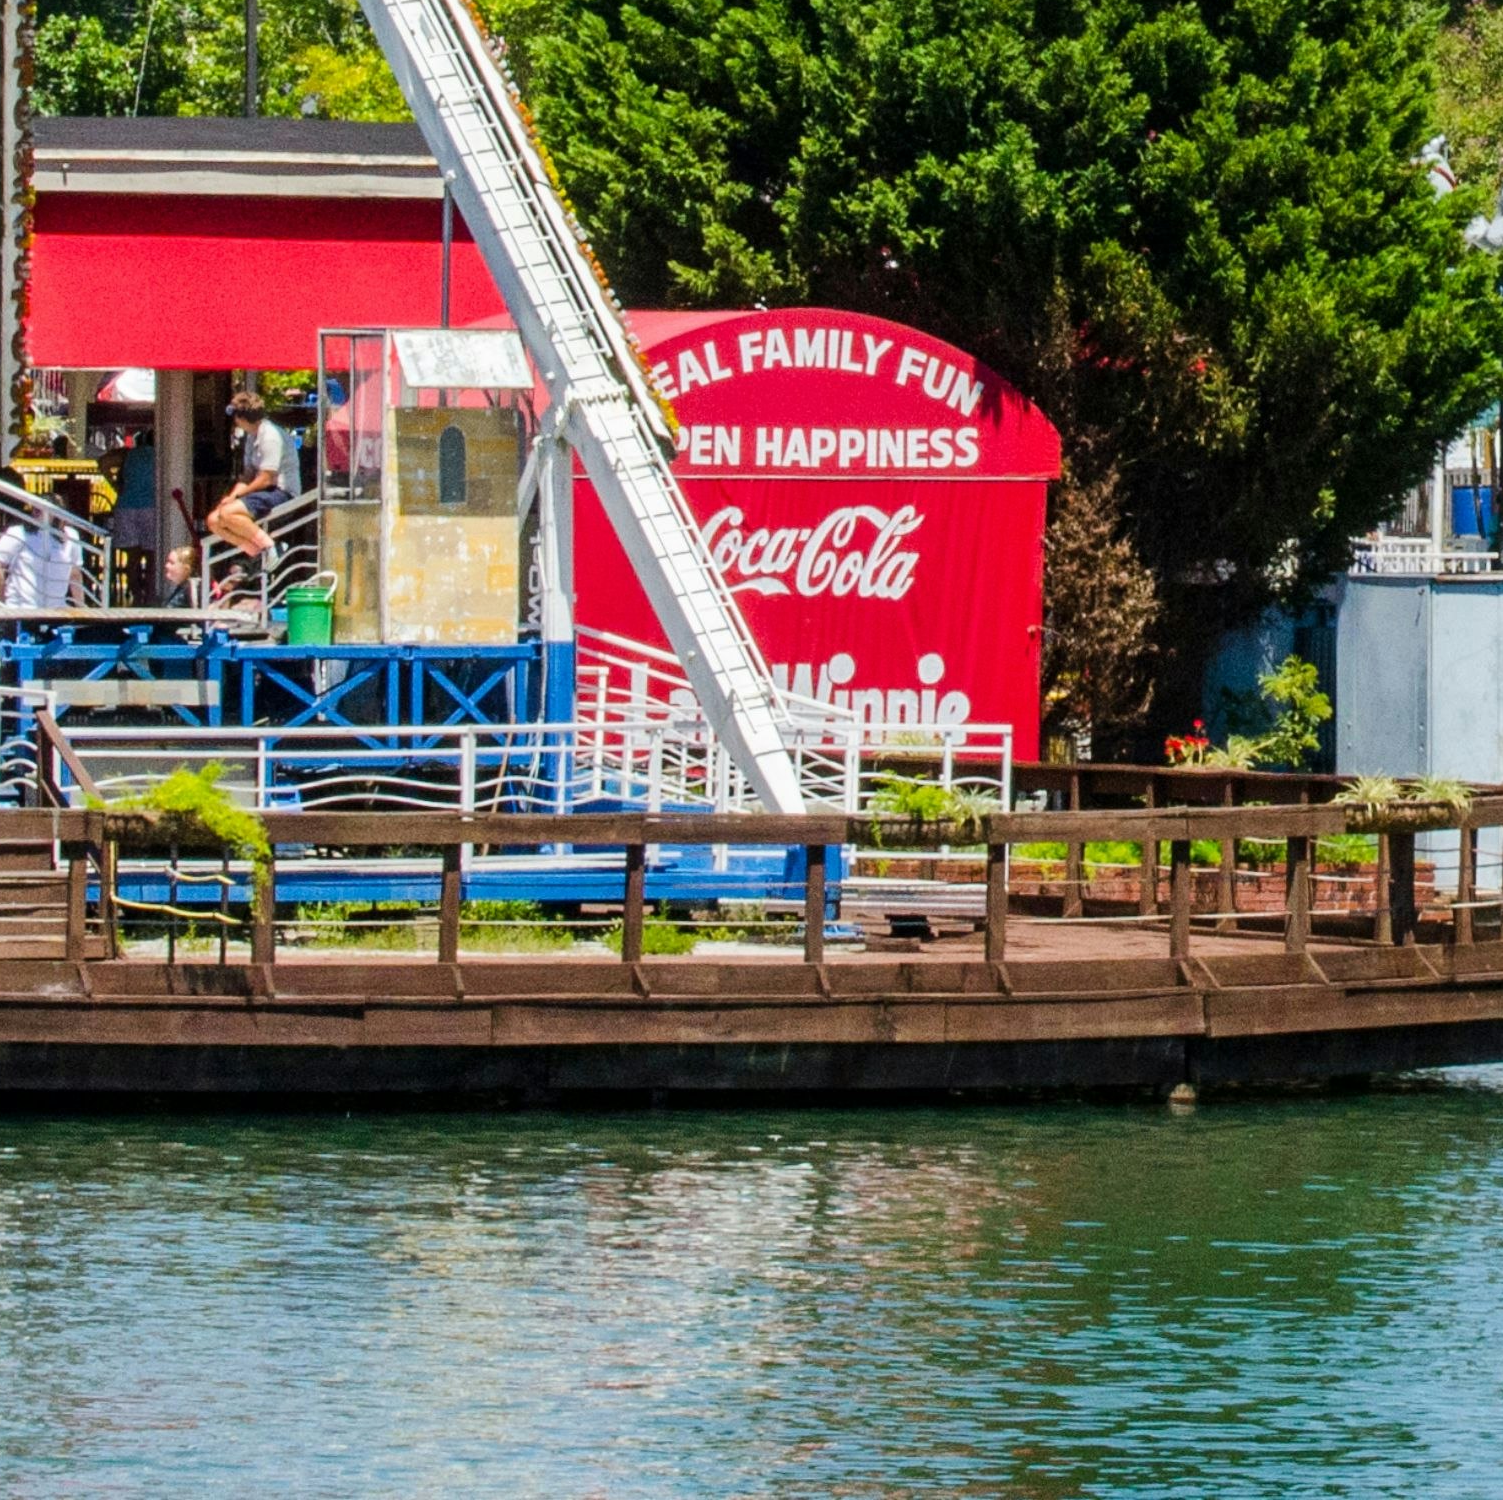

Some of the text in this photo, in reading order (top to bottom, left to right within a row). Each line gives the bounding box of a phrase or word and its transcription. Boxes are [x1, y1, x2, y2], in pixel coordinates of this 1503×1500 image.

[650, 327, 986, 418] EAL FAMILY FUN
[674, 425, 980, 469] PEN HAPPINESS
[700, 504, 926, 601] Coca-Cola
[771, 652, 971, 746] Winnie
